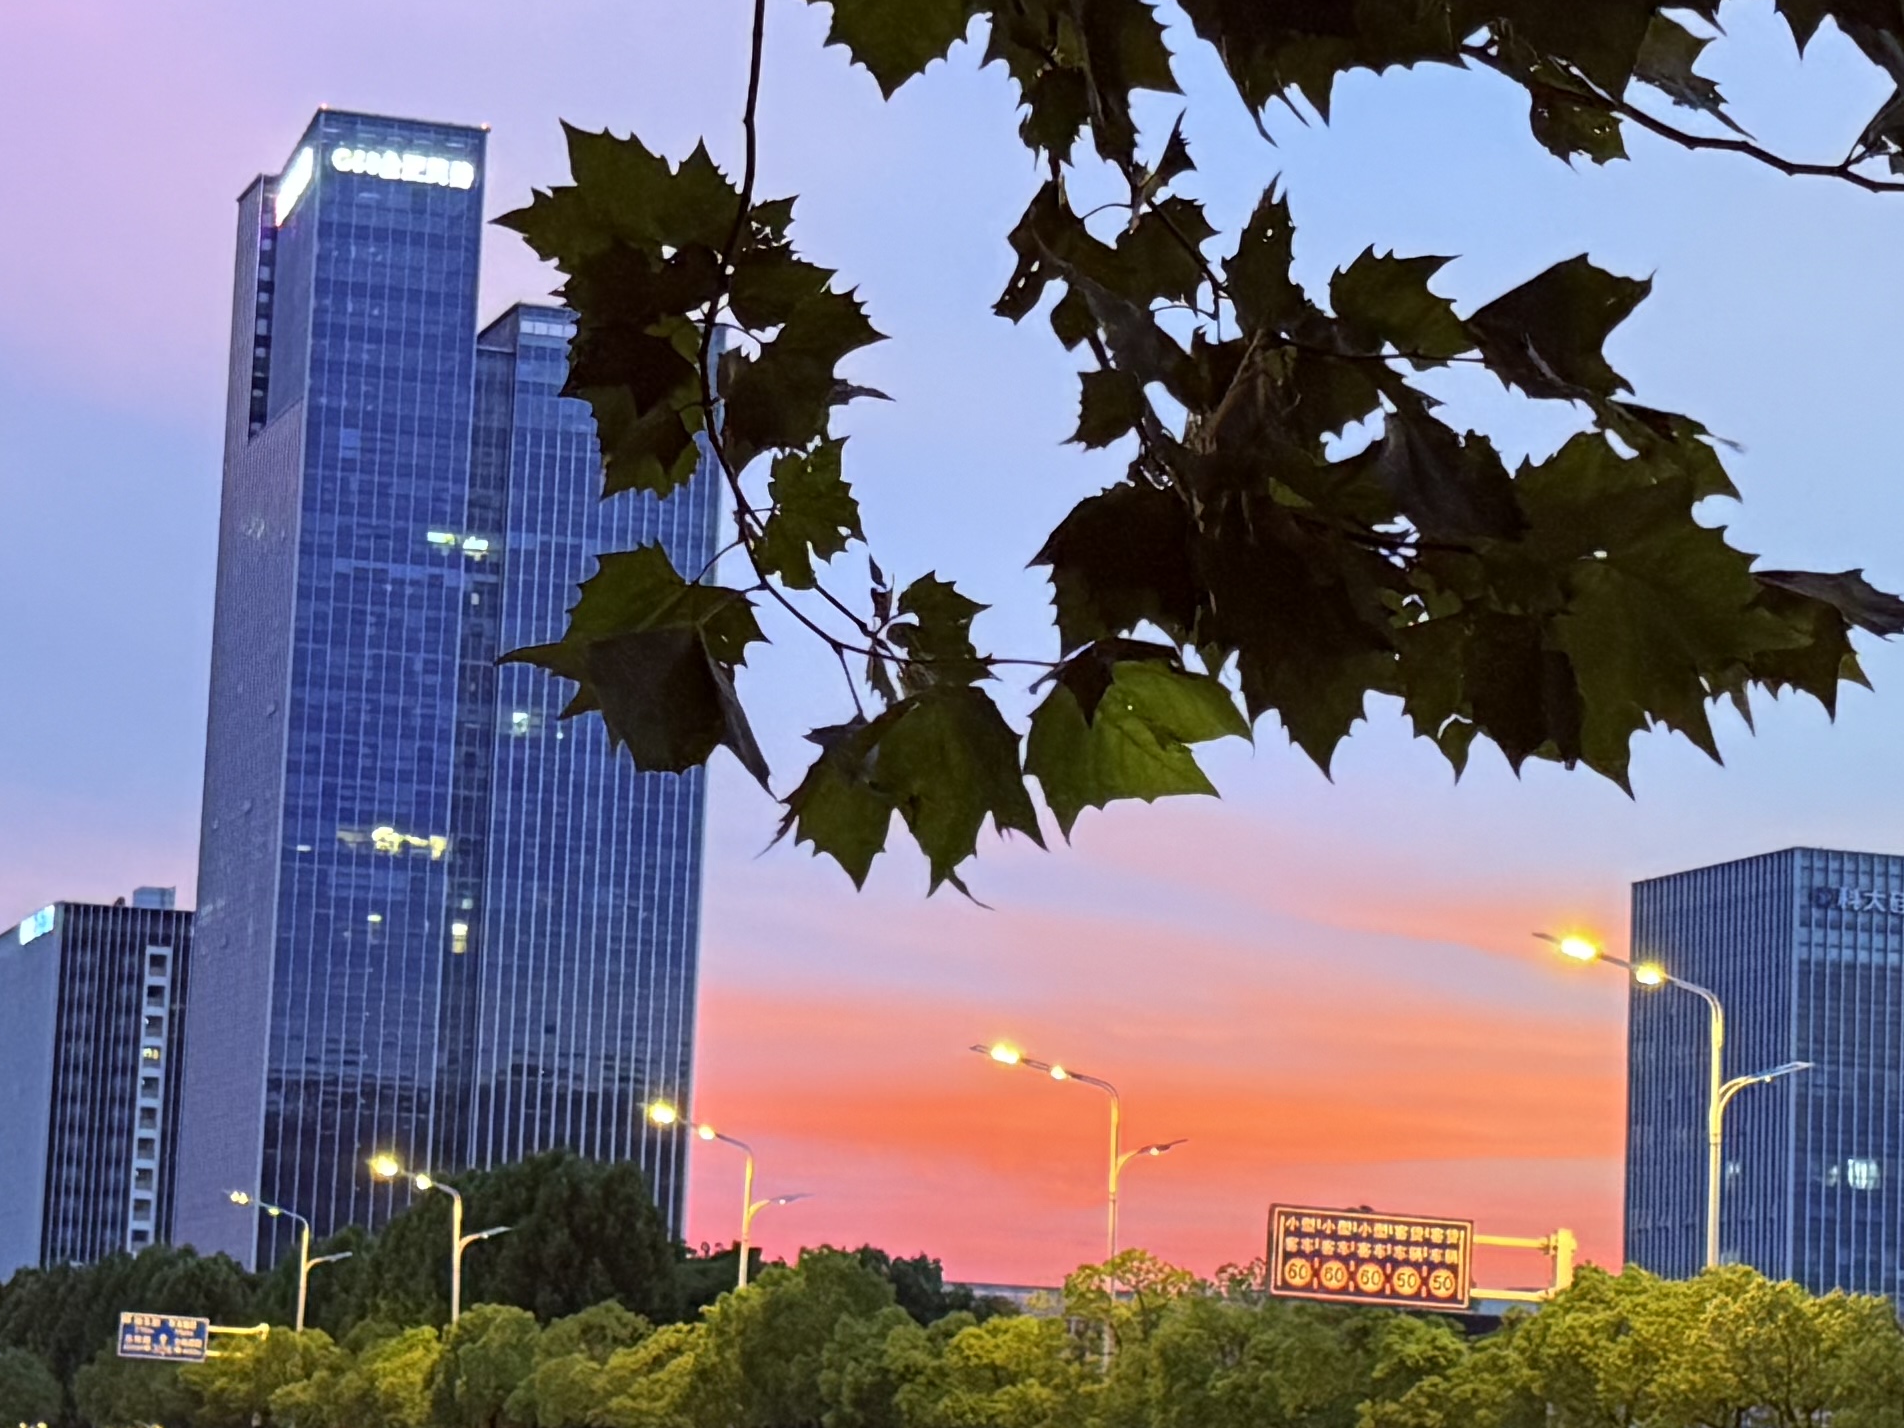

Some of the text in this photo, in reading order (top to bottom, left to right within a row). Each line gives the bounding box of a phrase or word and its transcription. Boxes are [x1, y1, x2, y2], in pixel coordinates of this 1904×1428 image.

[1286, 1216, 1315, 1233] 小型
[1322, 1219, 1352, 1236] 小型
[1358, 1222, 1388, 1239] 小型
[1288, 1263, 1453, 1291] 60 60 60 50 50
